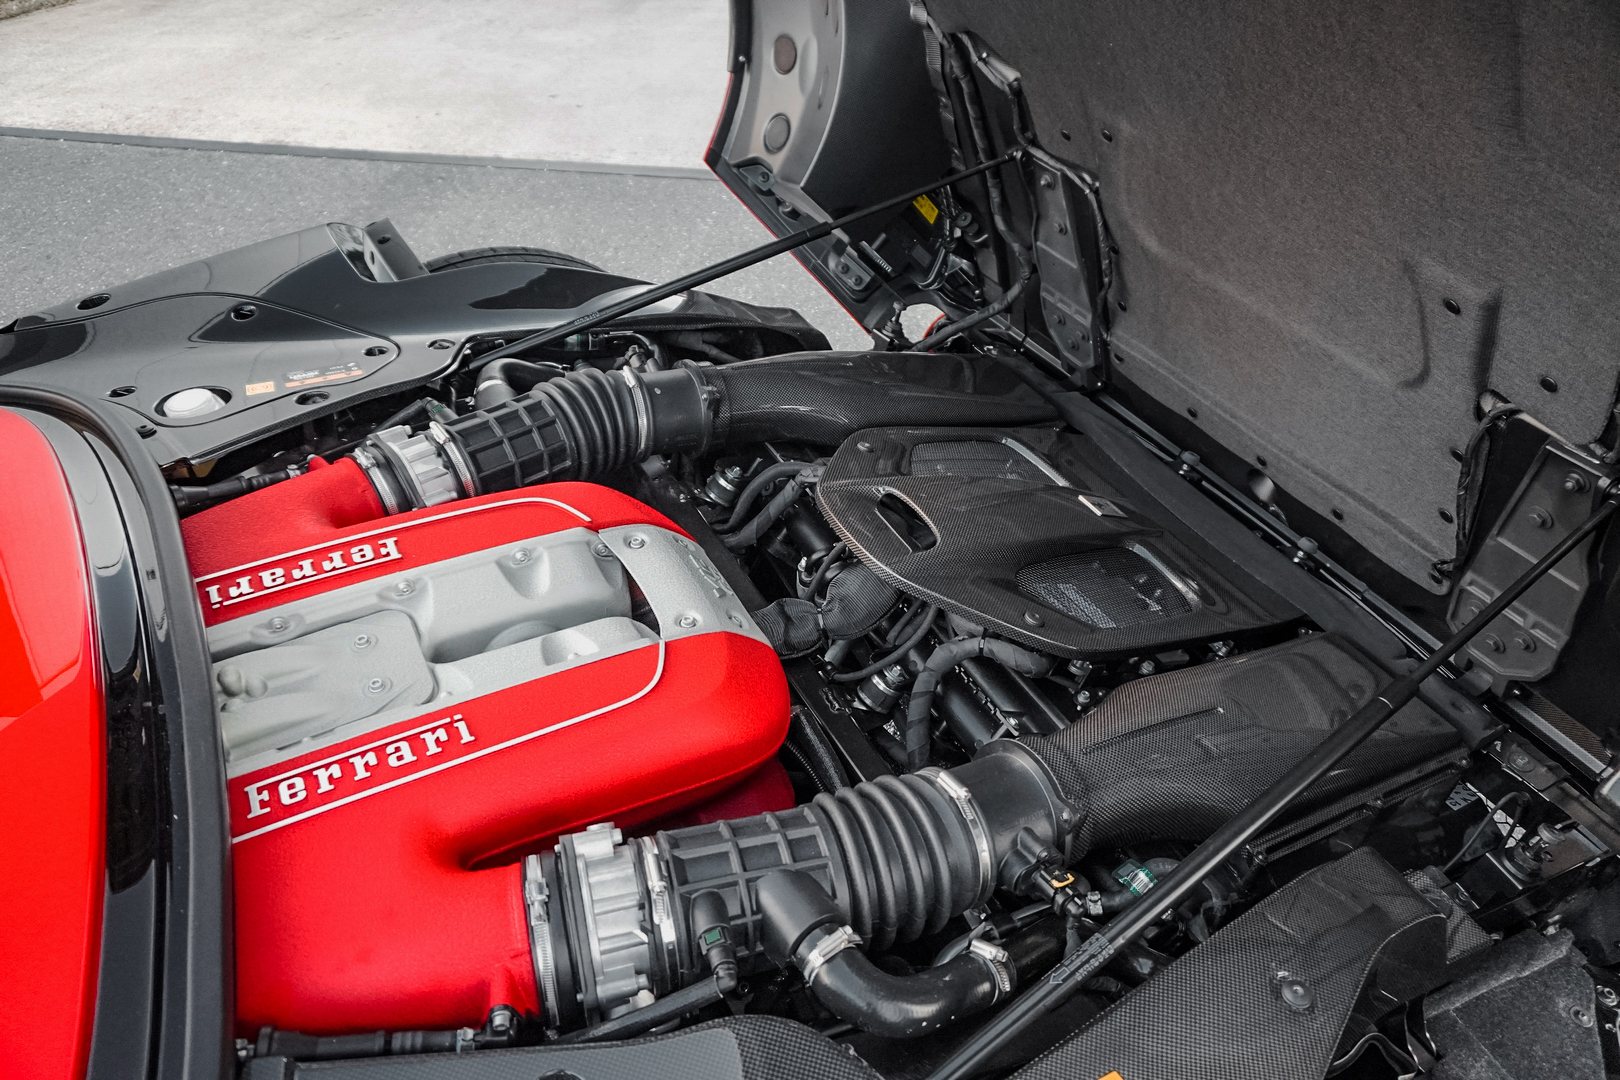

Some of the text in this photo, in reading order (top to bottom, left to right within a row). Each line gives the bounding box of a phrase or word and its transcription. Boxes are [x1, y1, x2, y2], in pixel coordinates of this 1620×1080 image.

[206, 537, 403, 609] Ferrari
[244, 714, 475, 818] Ferrari
[1077, 946, 1115, 981] STABILUS
